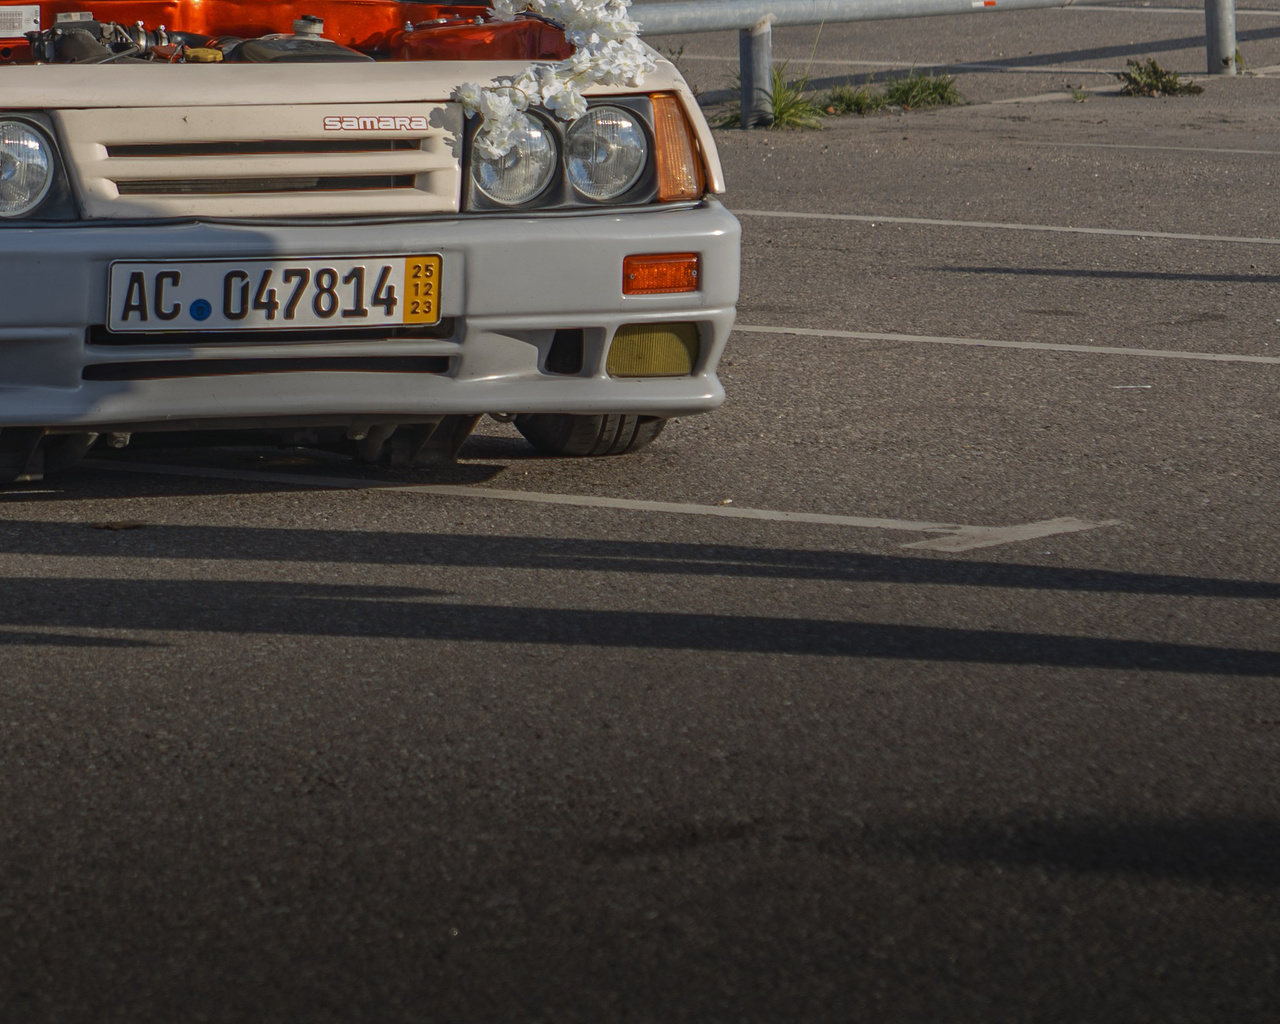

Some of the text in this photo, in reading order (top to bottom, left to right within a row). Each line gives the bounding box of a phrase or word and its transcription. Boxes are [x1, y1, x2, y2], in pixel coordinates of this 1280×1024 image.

[412, 264, 434, 278] 25
[121, 265, 398, 321] AC 047814
[412, 283, 433, 297] 12
[410, 300, 432, 315] 23
